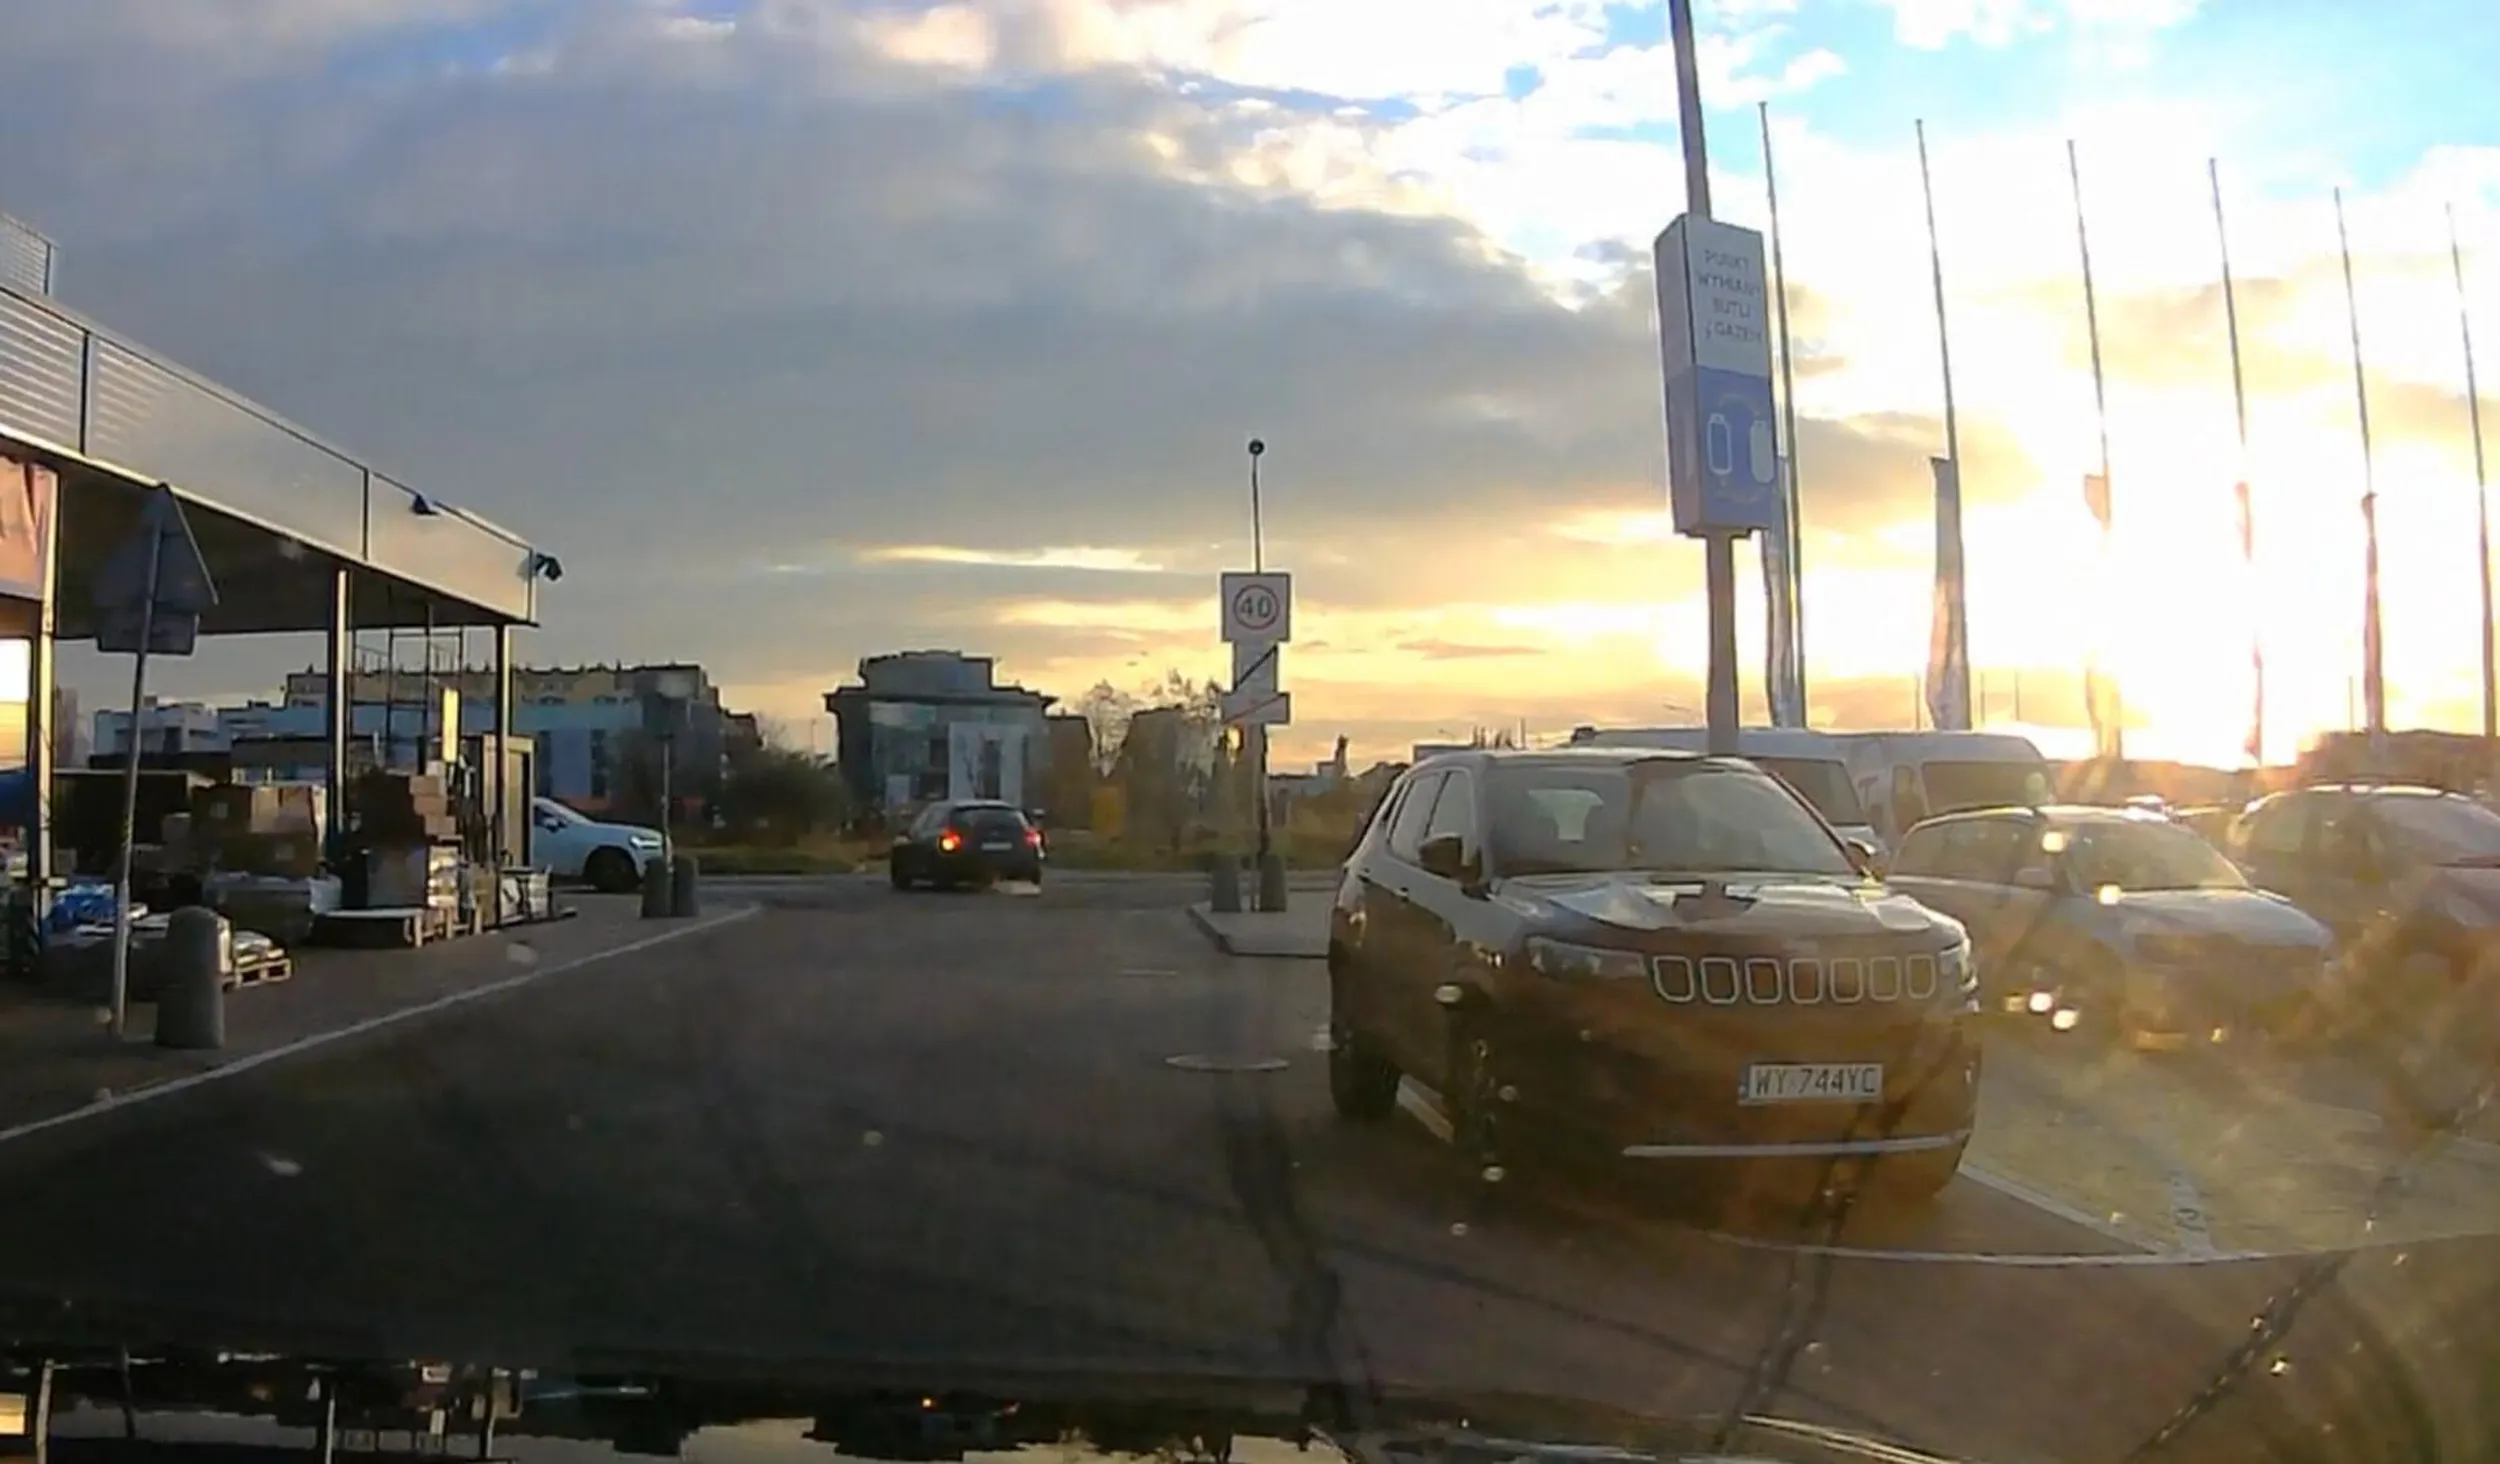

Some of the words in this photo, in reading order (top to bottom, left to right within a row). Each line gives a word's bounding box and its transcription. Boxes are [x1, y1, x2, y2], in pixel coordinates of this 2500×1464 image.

[1240, 595, 1272, 618] 40
[1755, 1067, 1787, 1096] WY
[1799, 1067, 1877, 1094] 744YC
